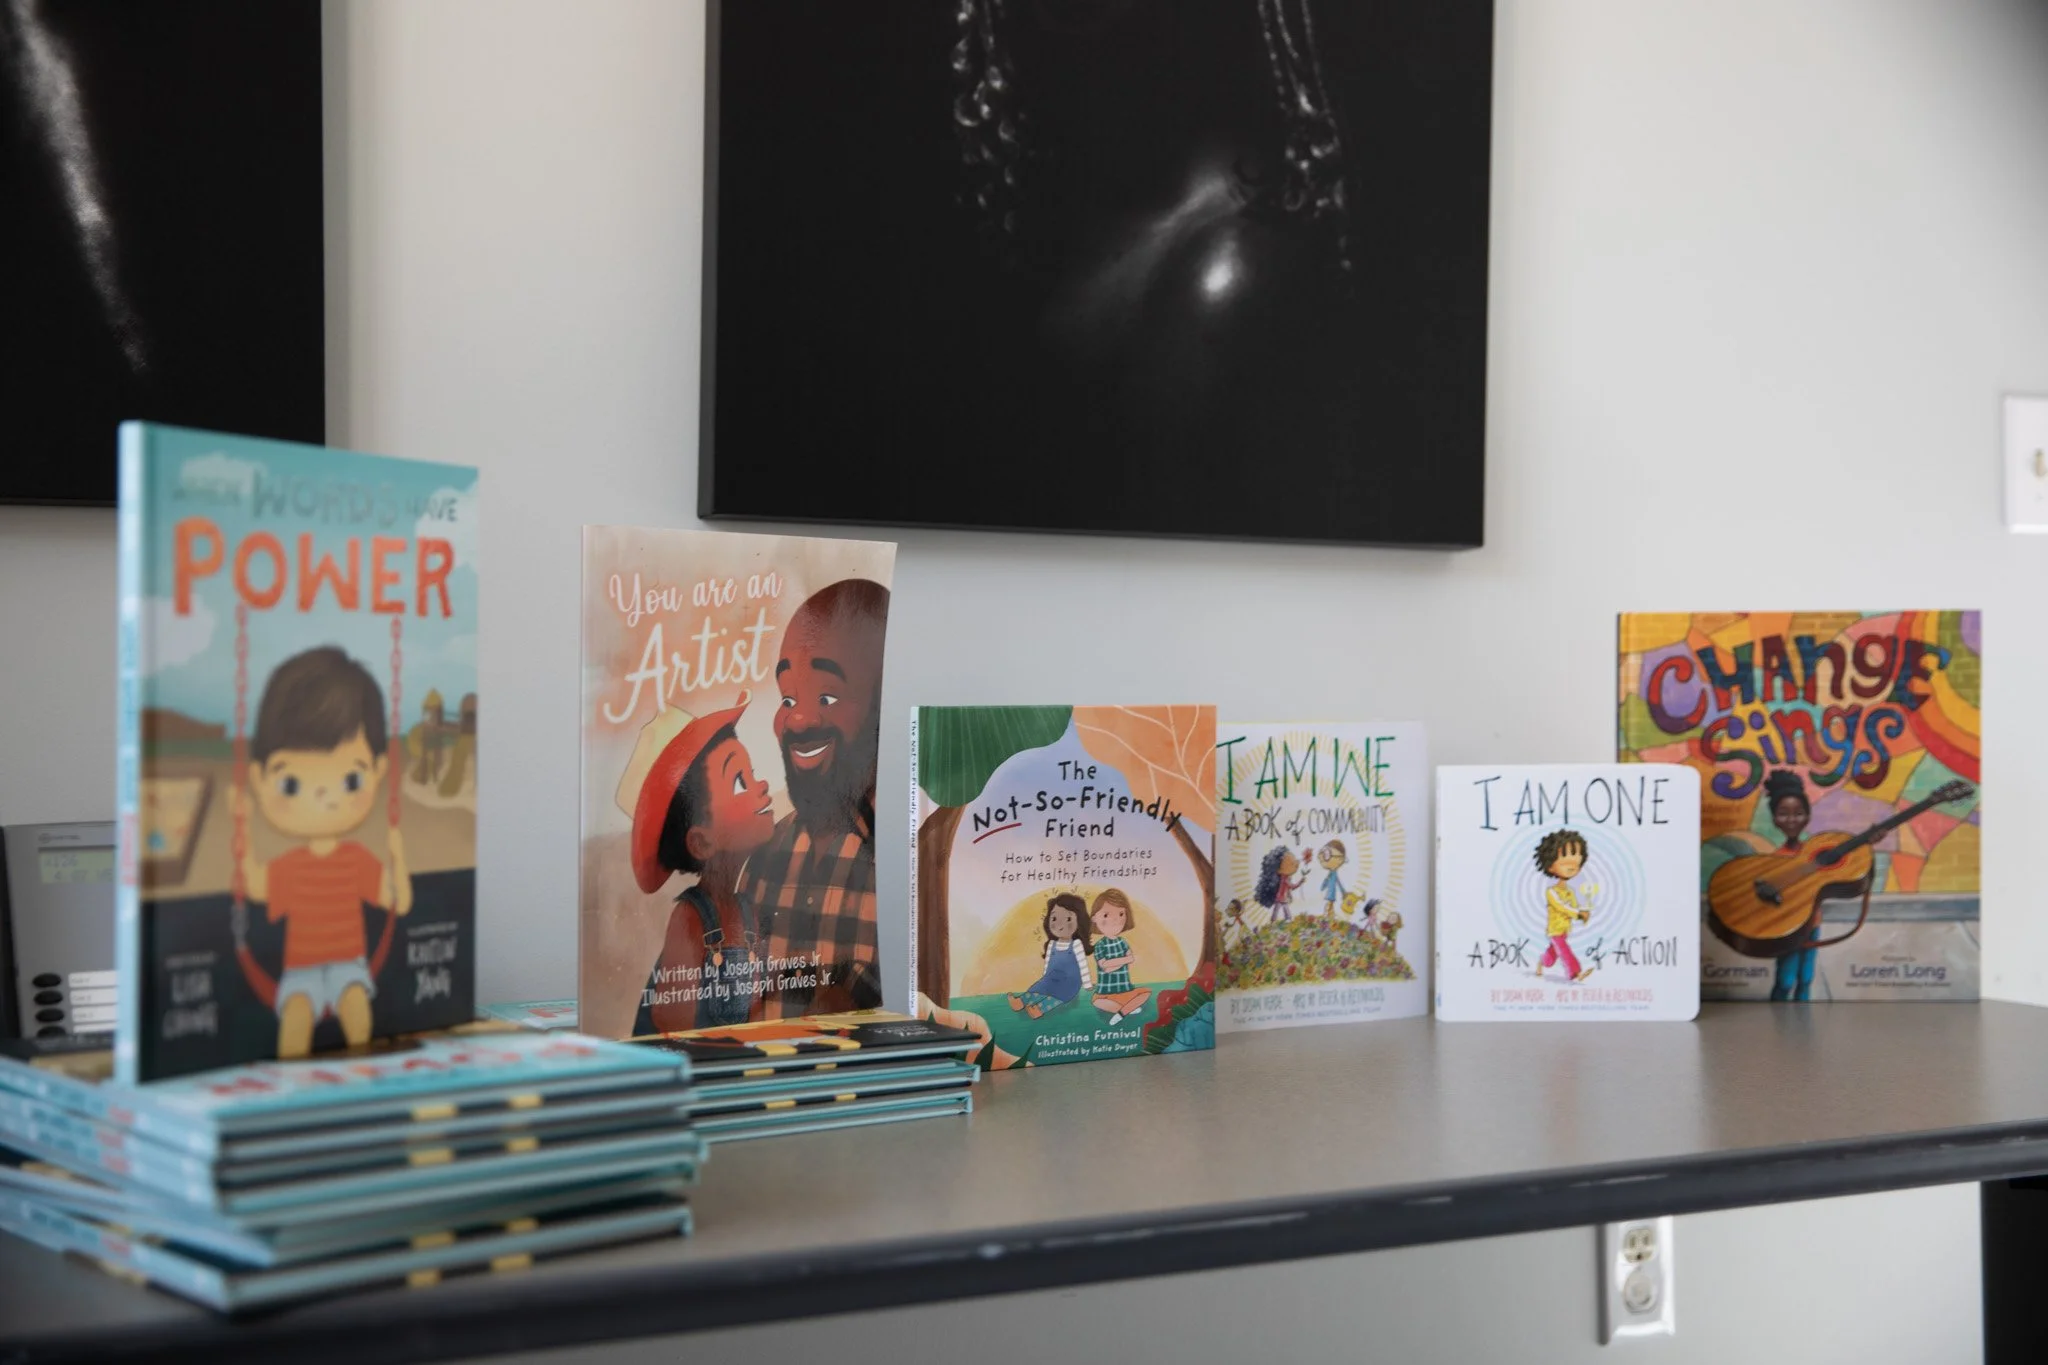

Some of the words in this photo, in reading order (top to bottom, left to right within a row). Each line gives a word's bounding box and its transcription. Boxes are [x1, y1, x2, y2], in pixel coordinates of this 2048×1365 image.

[172, 515, 455, 619] POWER
[608, 572, 682, 627] You
[693, 576, 738, 607] are
[746, 571, 783, 598] an
[603, 607, 776, 723] Artist
[1058, 760, 1097, 781] The
[1216, 736, 1246, 804] I
[1254, 736, 1317, 799] AM
[1334, 736, 1396, 797] WE
[973, 786, 1182, 832] Not-So-Friendly
[1473, 775, 1502, 831] I
[1513, 779, 1569, 825] AM
[1584, 776, 1670, 826] ONE
[1045, 817, 1115, 838] Friend
[1225, 811, 1240, 841] A
[1244, 805, 1282, 841] BOOK
[1285, 809, 1304, 846] of
[1308, 804, 1389, 835] COMMUNITY
[1005, 852, 1033, 864] How
[1039, 850, 1052, 862] to
[1057, 850, 1078, 862] Set
[1083, 847, 1153, 862] Boundaries
[1000, 869, 1021, 883] for
[1027, 867, 1077, 883] Healthy
[1083, 864, 1157, 879] Friendships
[652, 966, 702, 985] Written
[705, 962, 720, 983] by
[723, 957, 764, 980] Joseph
[767, 955, 807, 972] Graves
[810, 951, 825, 967] Jr.
[1466, 942, 1484, 969] A
[1488, 937, 1530, 969] BOOK
[1585, 936, 1607, 970] of
[1612, 936, 1678, 968] ACTION
[640, 981, 712, 1007] Illustrated
[715, 981, 730, 1002] by
[733, 974, 774, 998] Joseph
[777, 972, 817, 991] Graves
[820, 970, 836, 986] Jr.
[1850, 963, 1899, 979] Loren
[1902, 963, 1947, 981] Long
[1035, 1032, 1089, 1046] Christina
[1094, 1026, 1141, 1041] Furnival
[1038, 1047, 1079, 1058] Illustrated
[1080, 1046, 1091, 1056] by
[1114, 1043, 1138, 1053] Dwyer
